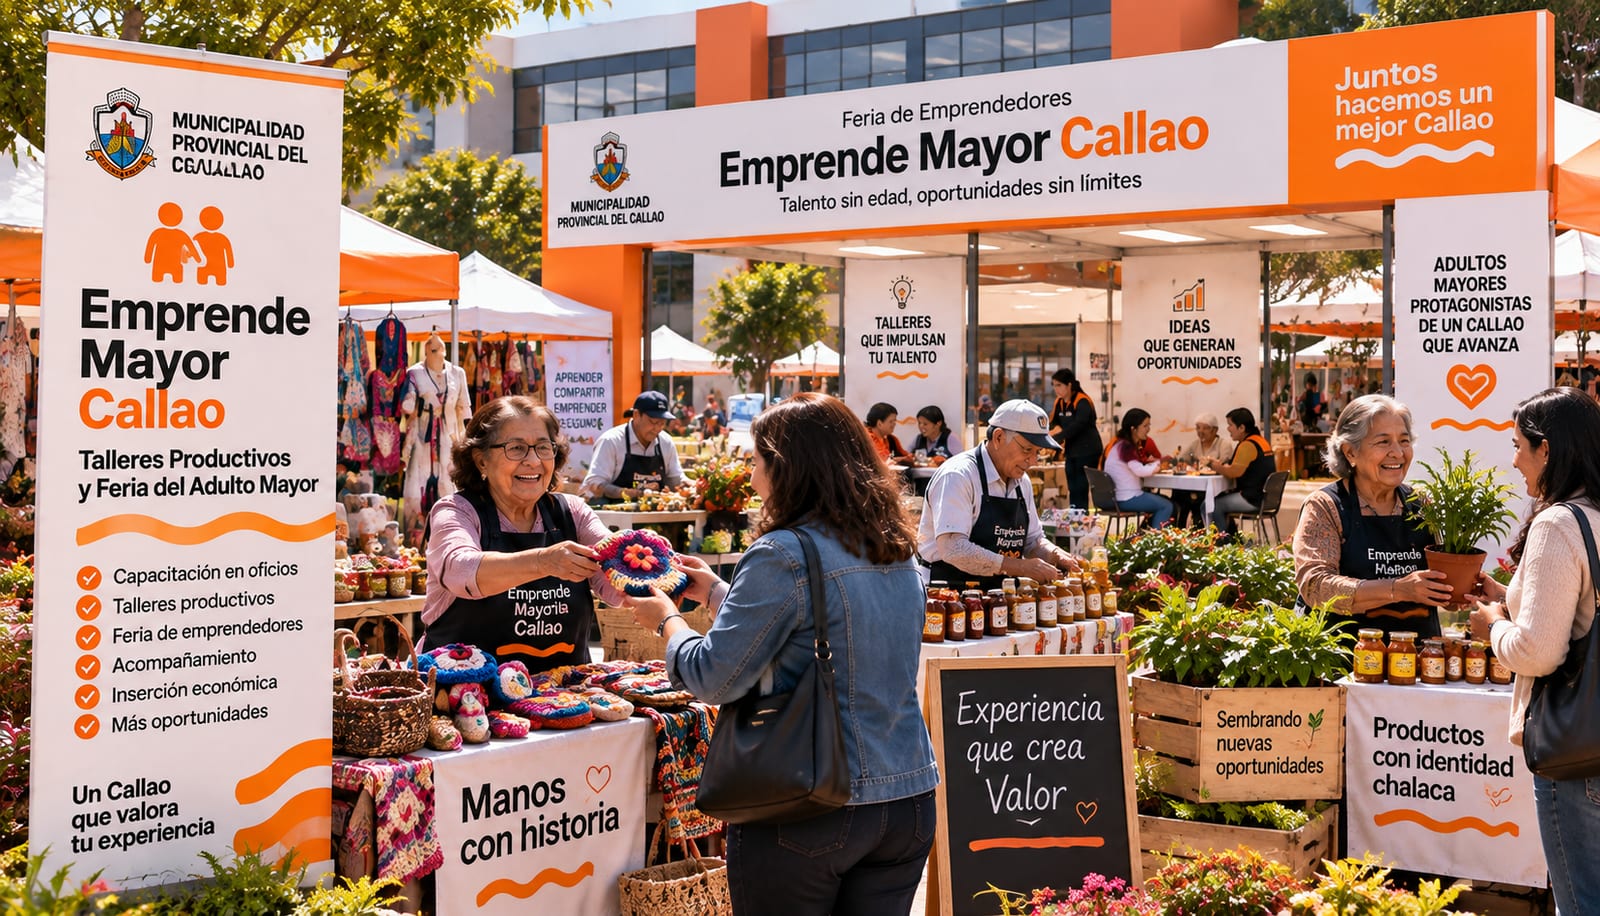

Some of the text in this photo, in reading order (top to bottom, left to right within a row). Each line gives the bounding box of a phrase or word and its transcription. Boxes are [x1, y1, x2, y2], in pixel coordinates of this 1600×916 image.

[1335, 63, 1437, 91] Juntos
[843, 91, 1072, 128] Feria de Emprendedores
[1336, 85, 1492, 116] hacemos un
[173, 112, 304, 140] MUNICIPALIDAD
[1336, 109, 1493, 143] mejor Callao
[173, 134, 308, 164] PROVINCIAL DEL
[720, 110, 1209, 195] Emprende Mayor Callao
[571, 196, 650, 213] MUNICIPALIDAD
[779, 172, 1142, 212] Talento sin edad, oportunidades sin límites
[558, 211, 664, 228] PROVINCIAL DEL CALLAO
[1434, 254, 1506, 272] ADULTOS
[1434, 276, 1507, 292] MAYORES
[81, 288, 310, 341] Emprende
[1411, 296, 1531, 313] PROTAGONISTAS
[875, 316, 931, 329] TALLERES
[1170, 319, 1210, 333] IDEAS
[1419, 316, 1524, 333] DE UN CALLAO
[861, 333, 945, 348] QUE IMPULSAN
[1144, 338, 1235, 353] QUE GENERAN
[1423, 337, 1519, 354] QUE AVANZA
[81, 338, 229, 390] Mayor
[869, 351, 937, 364] TU TALENTO
[1137, 356, 1241, 369] OPORTUNIDADES
[555, 372, 603, 383] APRENDER
[554, 387, 605, 398] COMPARTIR
[79, 388, 225, 430] Callao
[554, 403, 606, 413] EMPRENDER
[79, 448, 291, 470] Talleres Productivos
[78, 475, 319, 504] y Feria del Adulto Mayor
[114, 561, 298, 587] Capacitación en oficios
[113, 591, 274, 614] Talleres productivos
[508, 583, 571, 603] Emprende
[113, 618, 303, 644] Feria de emprendedores
[515, 620, 562, 636] Callao
[112, 649, 256, 673] Acompañamiento
[113, 675, 277, 703] Inserción económica
[112, 704, 268, 733] Más oportunidades
[957, 690, 1104, 734] Experiencia
[1217, 710, 1301, 728] Sembrando
[1217, 738, 1272, 751] nuevas
[1374, 717, 1484, 746] Productos
[967, 739, 1085, 774] que crea
[1216, 756, 1323, 780] oportunidades
[1373, 748, 1513, 777] con identidad
[73, 778, 171, 805] Un Callao
[986, 773, 1067, 814] Valor
[1373, 773, 1455, 801] chalaca
[462, 778, 565, 823] Manos
[72, 801, 179, 832] que valora
[71, 817, 215, 853] tu experiencia
[461, 801, 619, 865] con historia
